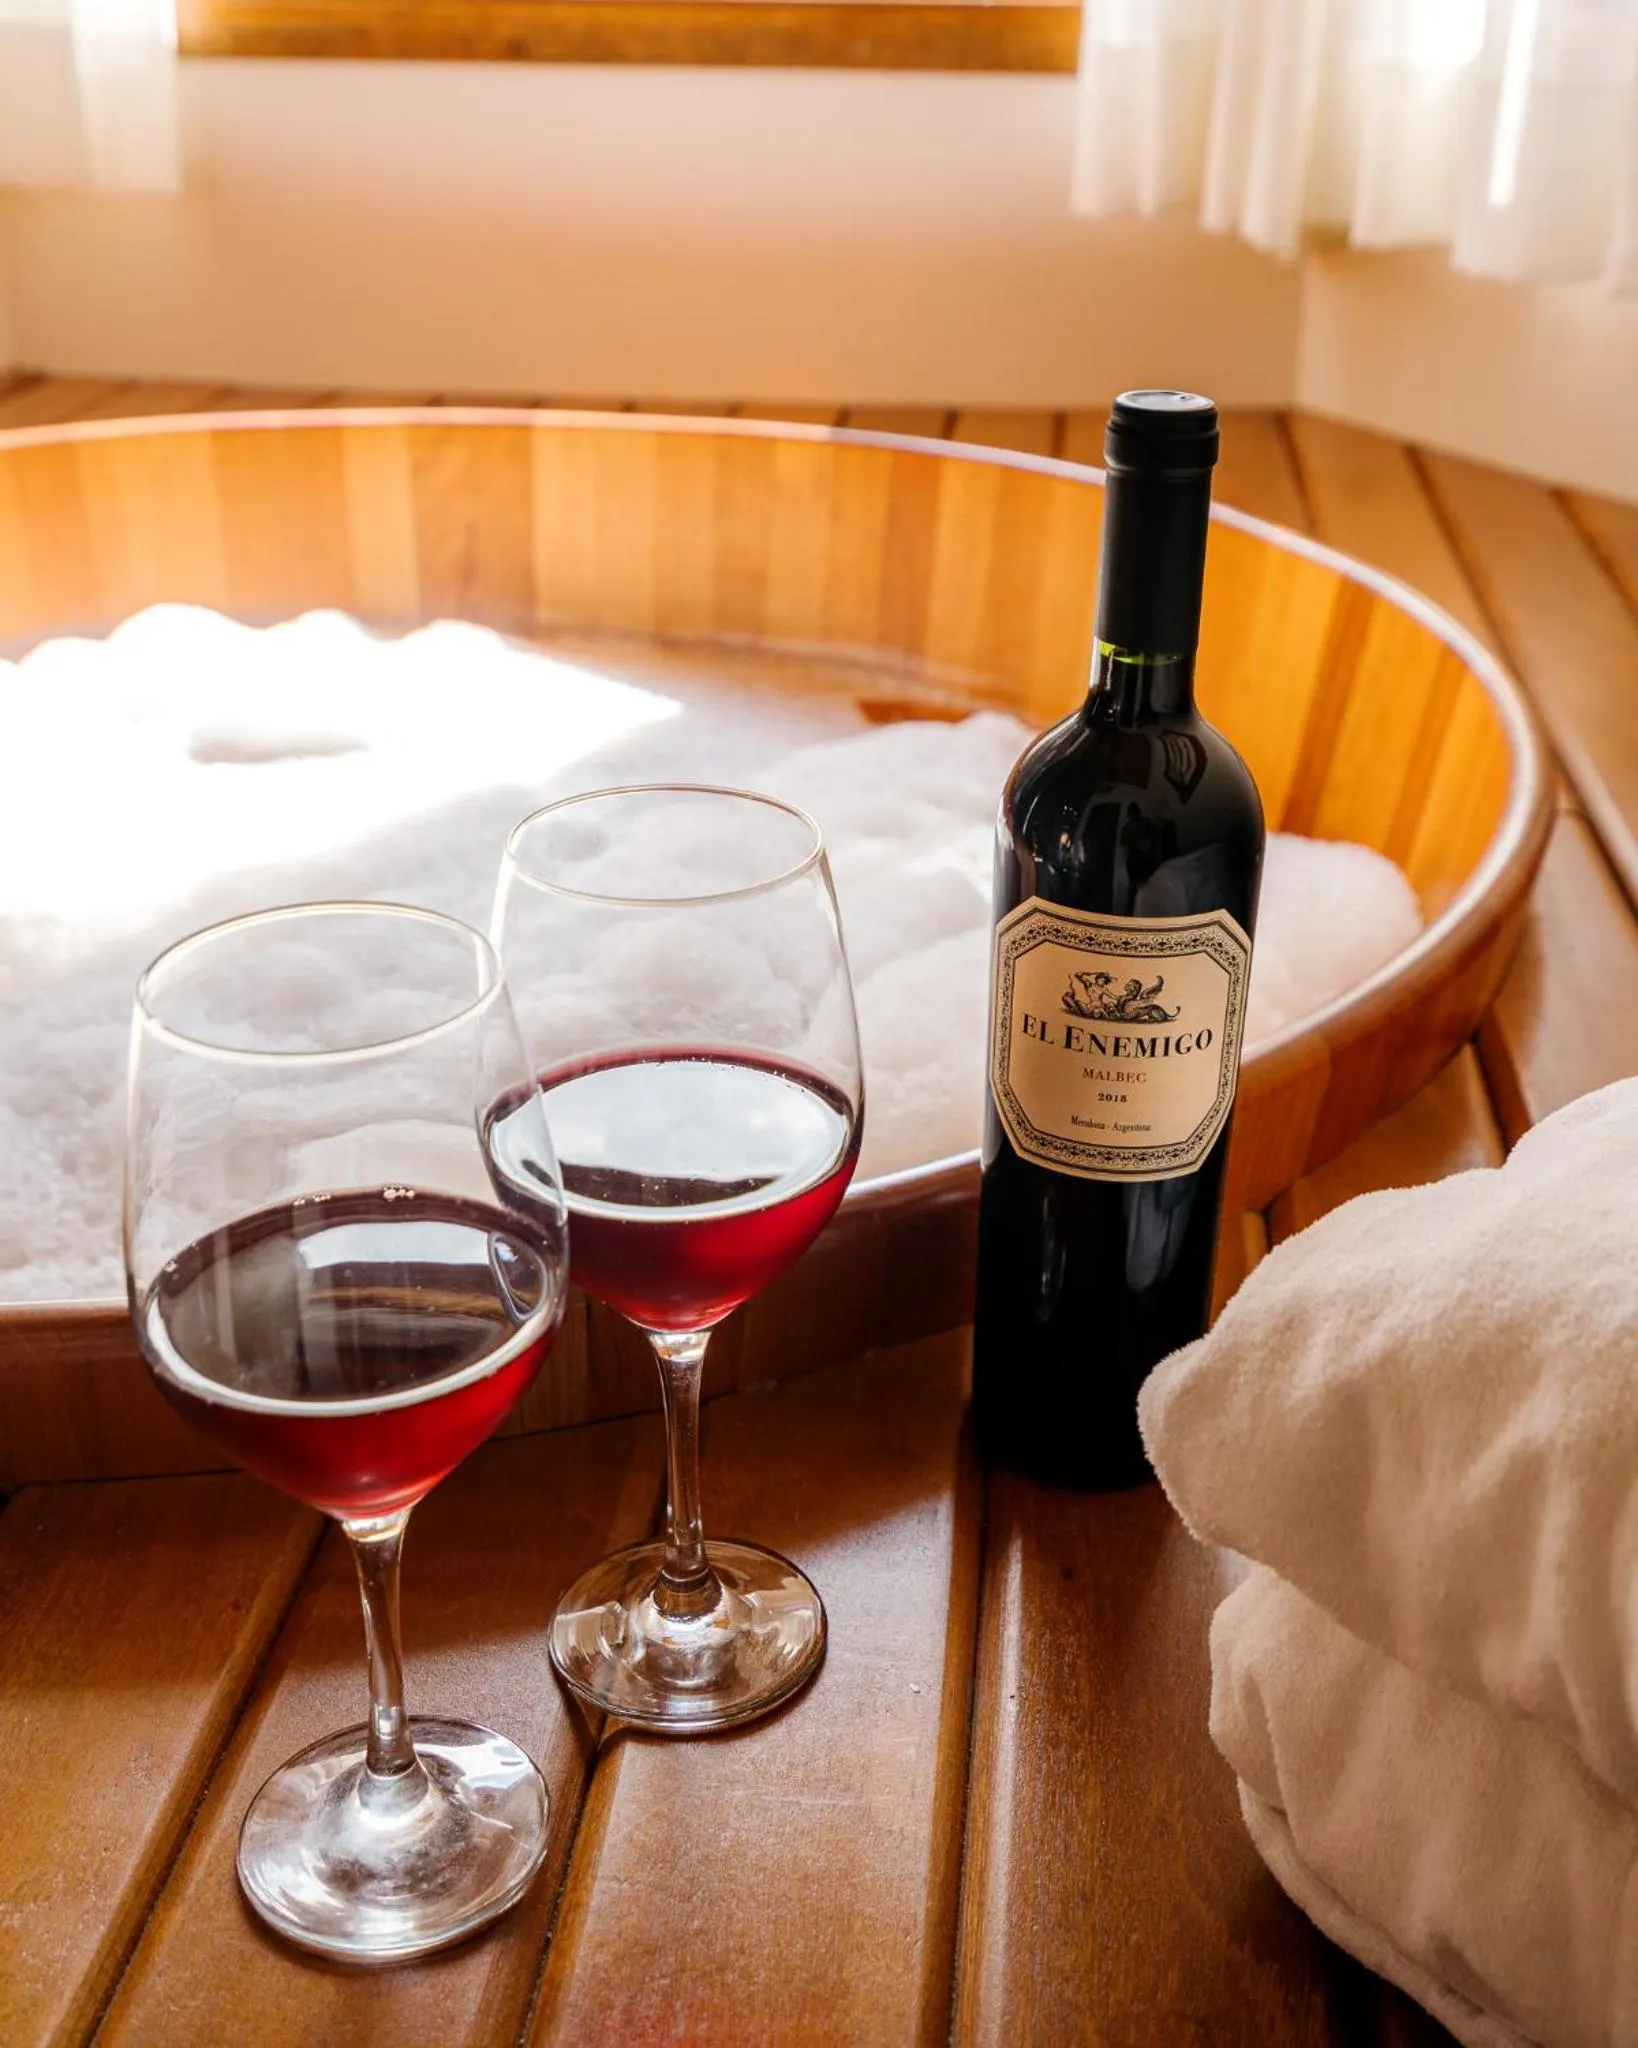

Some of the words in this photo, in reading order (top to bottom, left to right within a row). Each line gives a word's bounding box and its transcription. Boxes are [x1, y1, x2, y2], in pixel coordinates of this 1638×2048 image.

[1022, 1013, 1055, 1045] EL
[1064, 1025, 1213, 1058] ENEMIGO
[1083, 1068, 1147, 1084] MALBEC
[1098, 1092, 1128, 1103] 2018
[1071, 1115, 1106, 1130] Mendoza
[1112, 1121, 1151, 1134] Argentina
